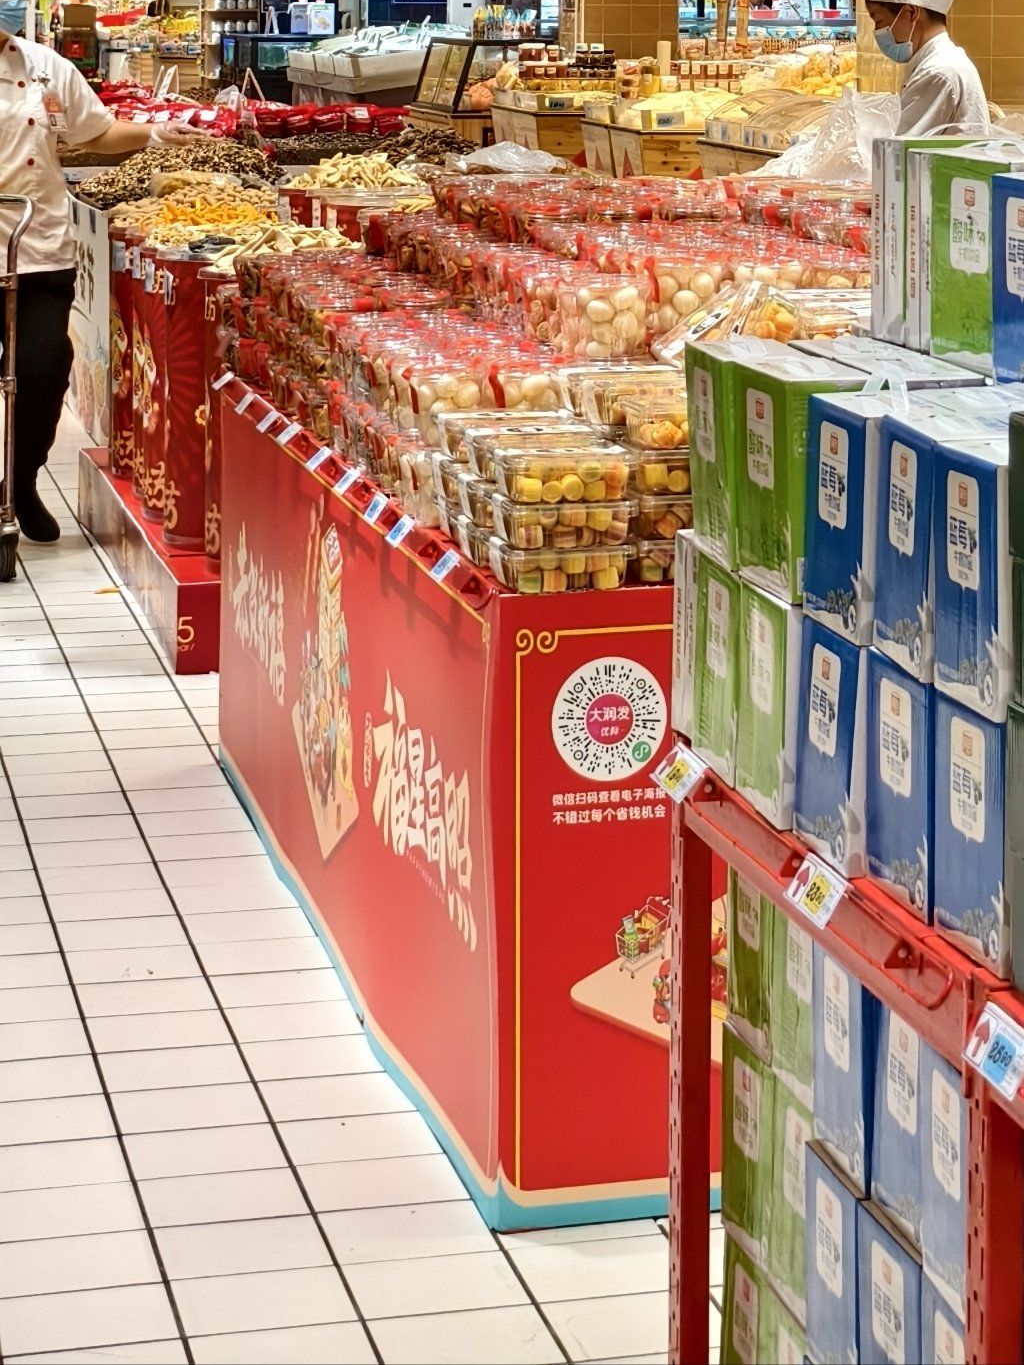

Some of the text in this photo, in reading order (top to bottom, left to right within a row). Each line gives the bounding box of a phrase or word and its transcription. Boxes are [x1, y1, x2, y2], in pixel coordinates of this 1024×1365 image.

[589, 706, 630, 722] 大润发
[552, 787, 666, 806] 微信扫码查看电子海报
[552, 804, 666, 824] 不错过每个省钱机会
